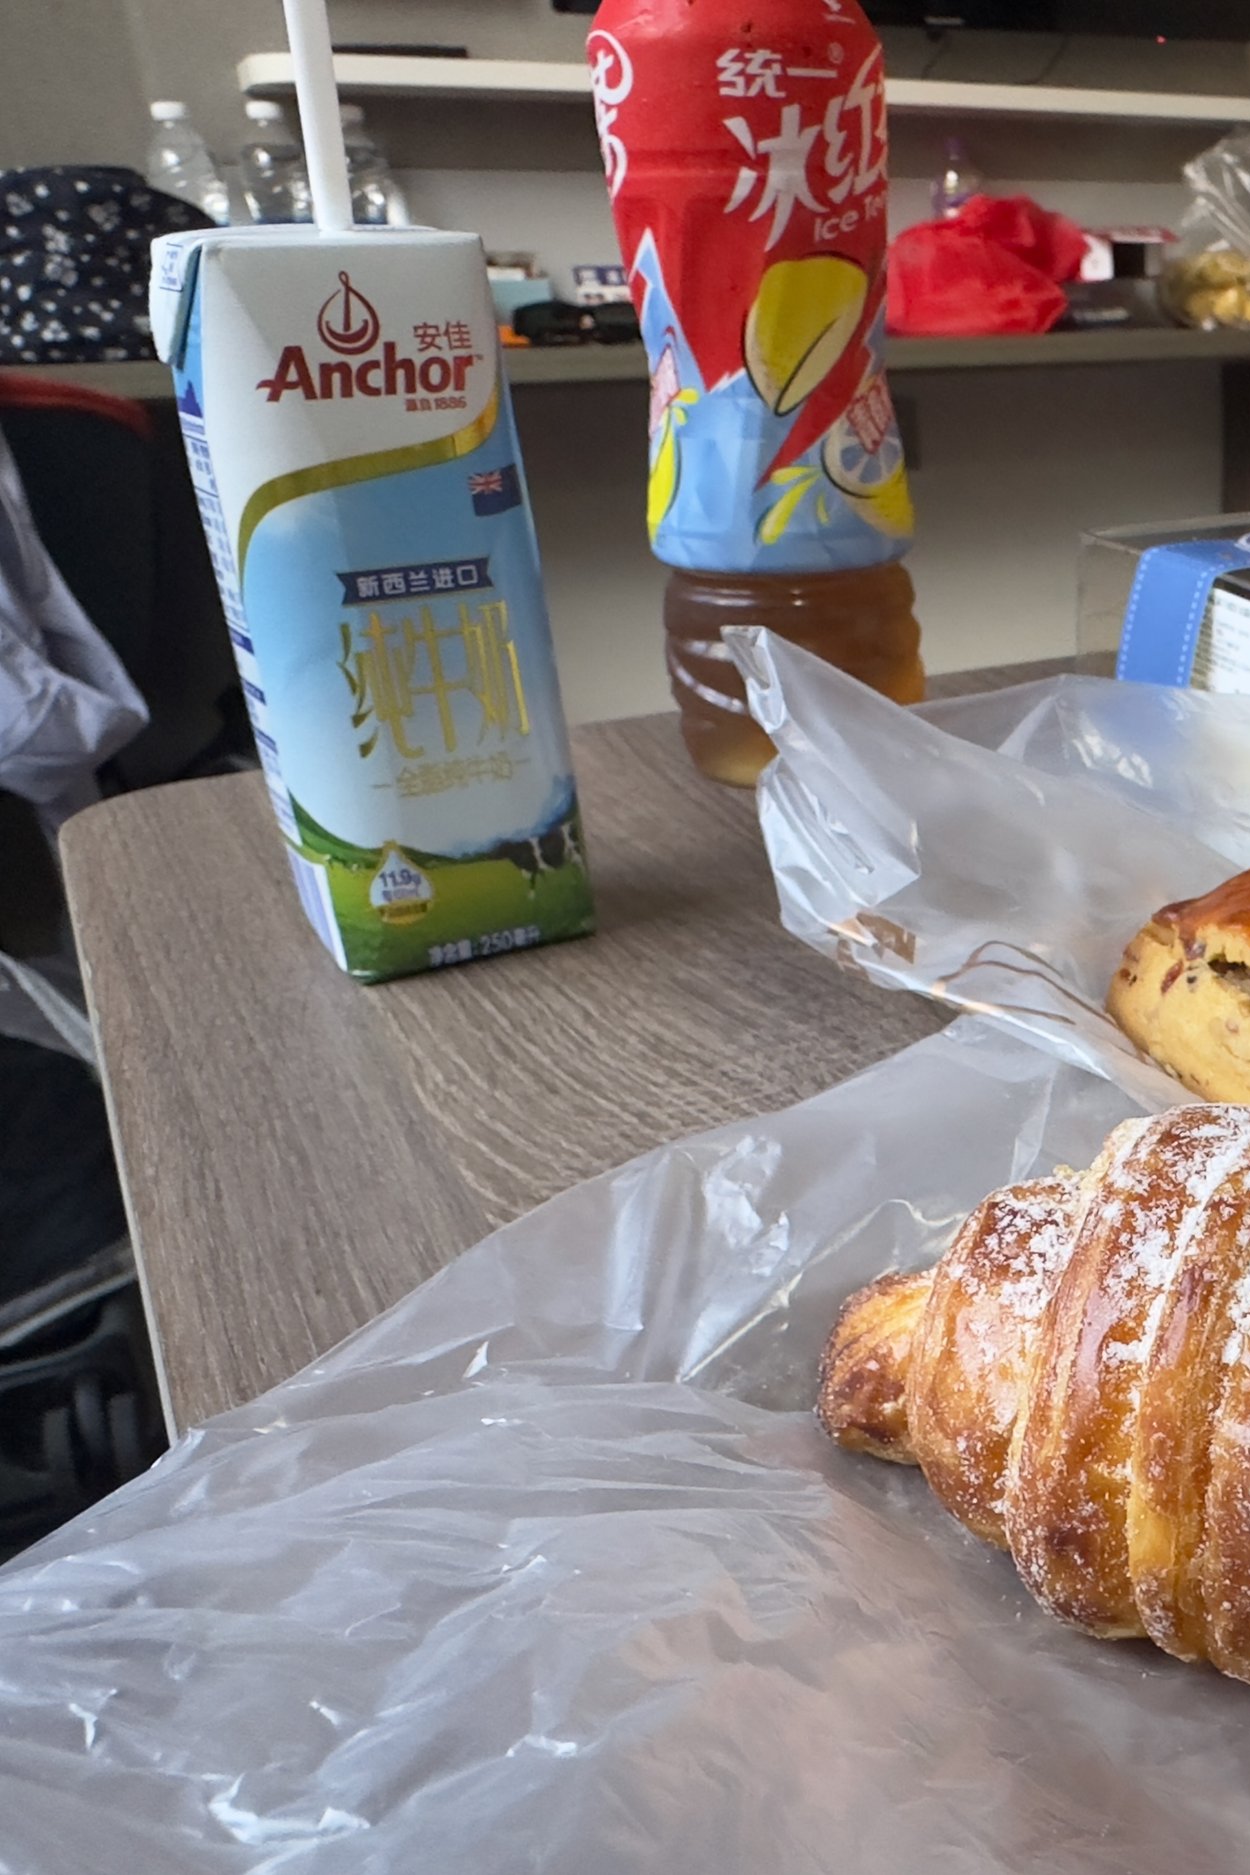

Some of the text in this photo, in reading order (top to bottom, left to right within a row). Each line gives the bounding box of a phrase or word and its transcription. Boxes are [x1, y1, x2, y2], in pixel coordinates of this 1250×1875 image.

[716, 48, 838, 97] 统一
[722, 44, 888, 253] 冰红
[814, 208, 860, 244] Ice
[413, 321, 472, 352] 安佳
[256, 341, 474, 402] Anchor
[356, 565, 478, 597] 新西兰进口
[337, 600, 529, 758] 纯牛奶
